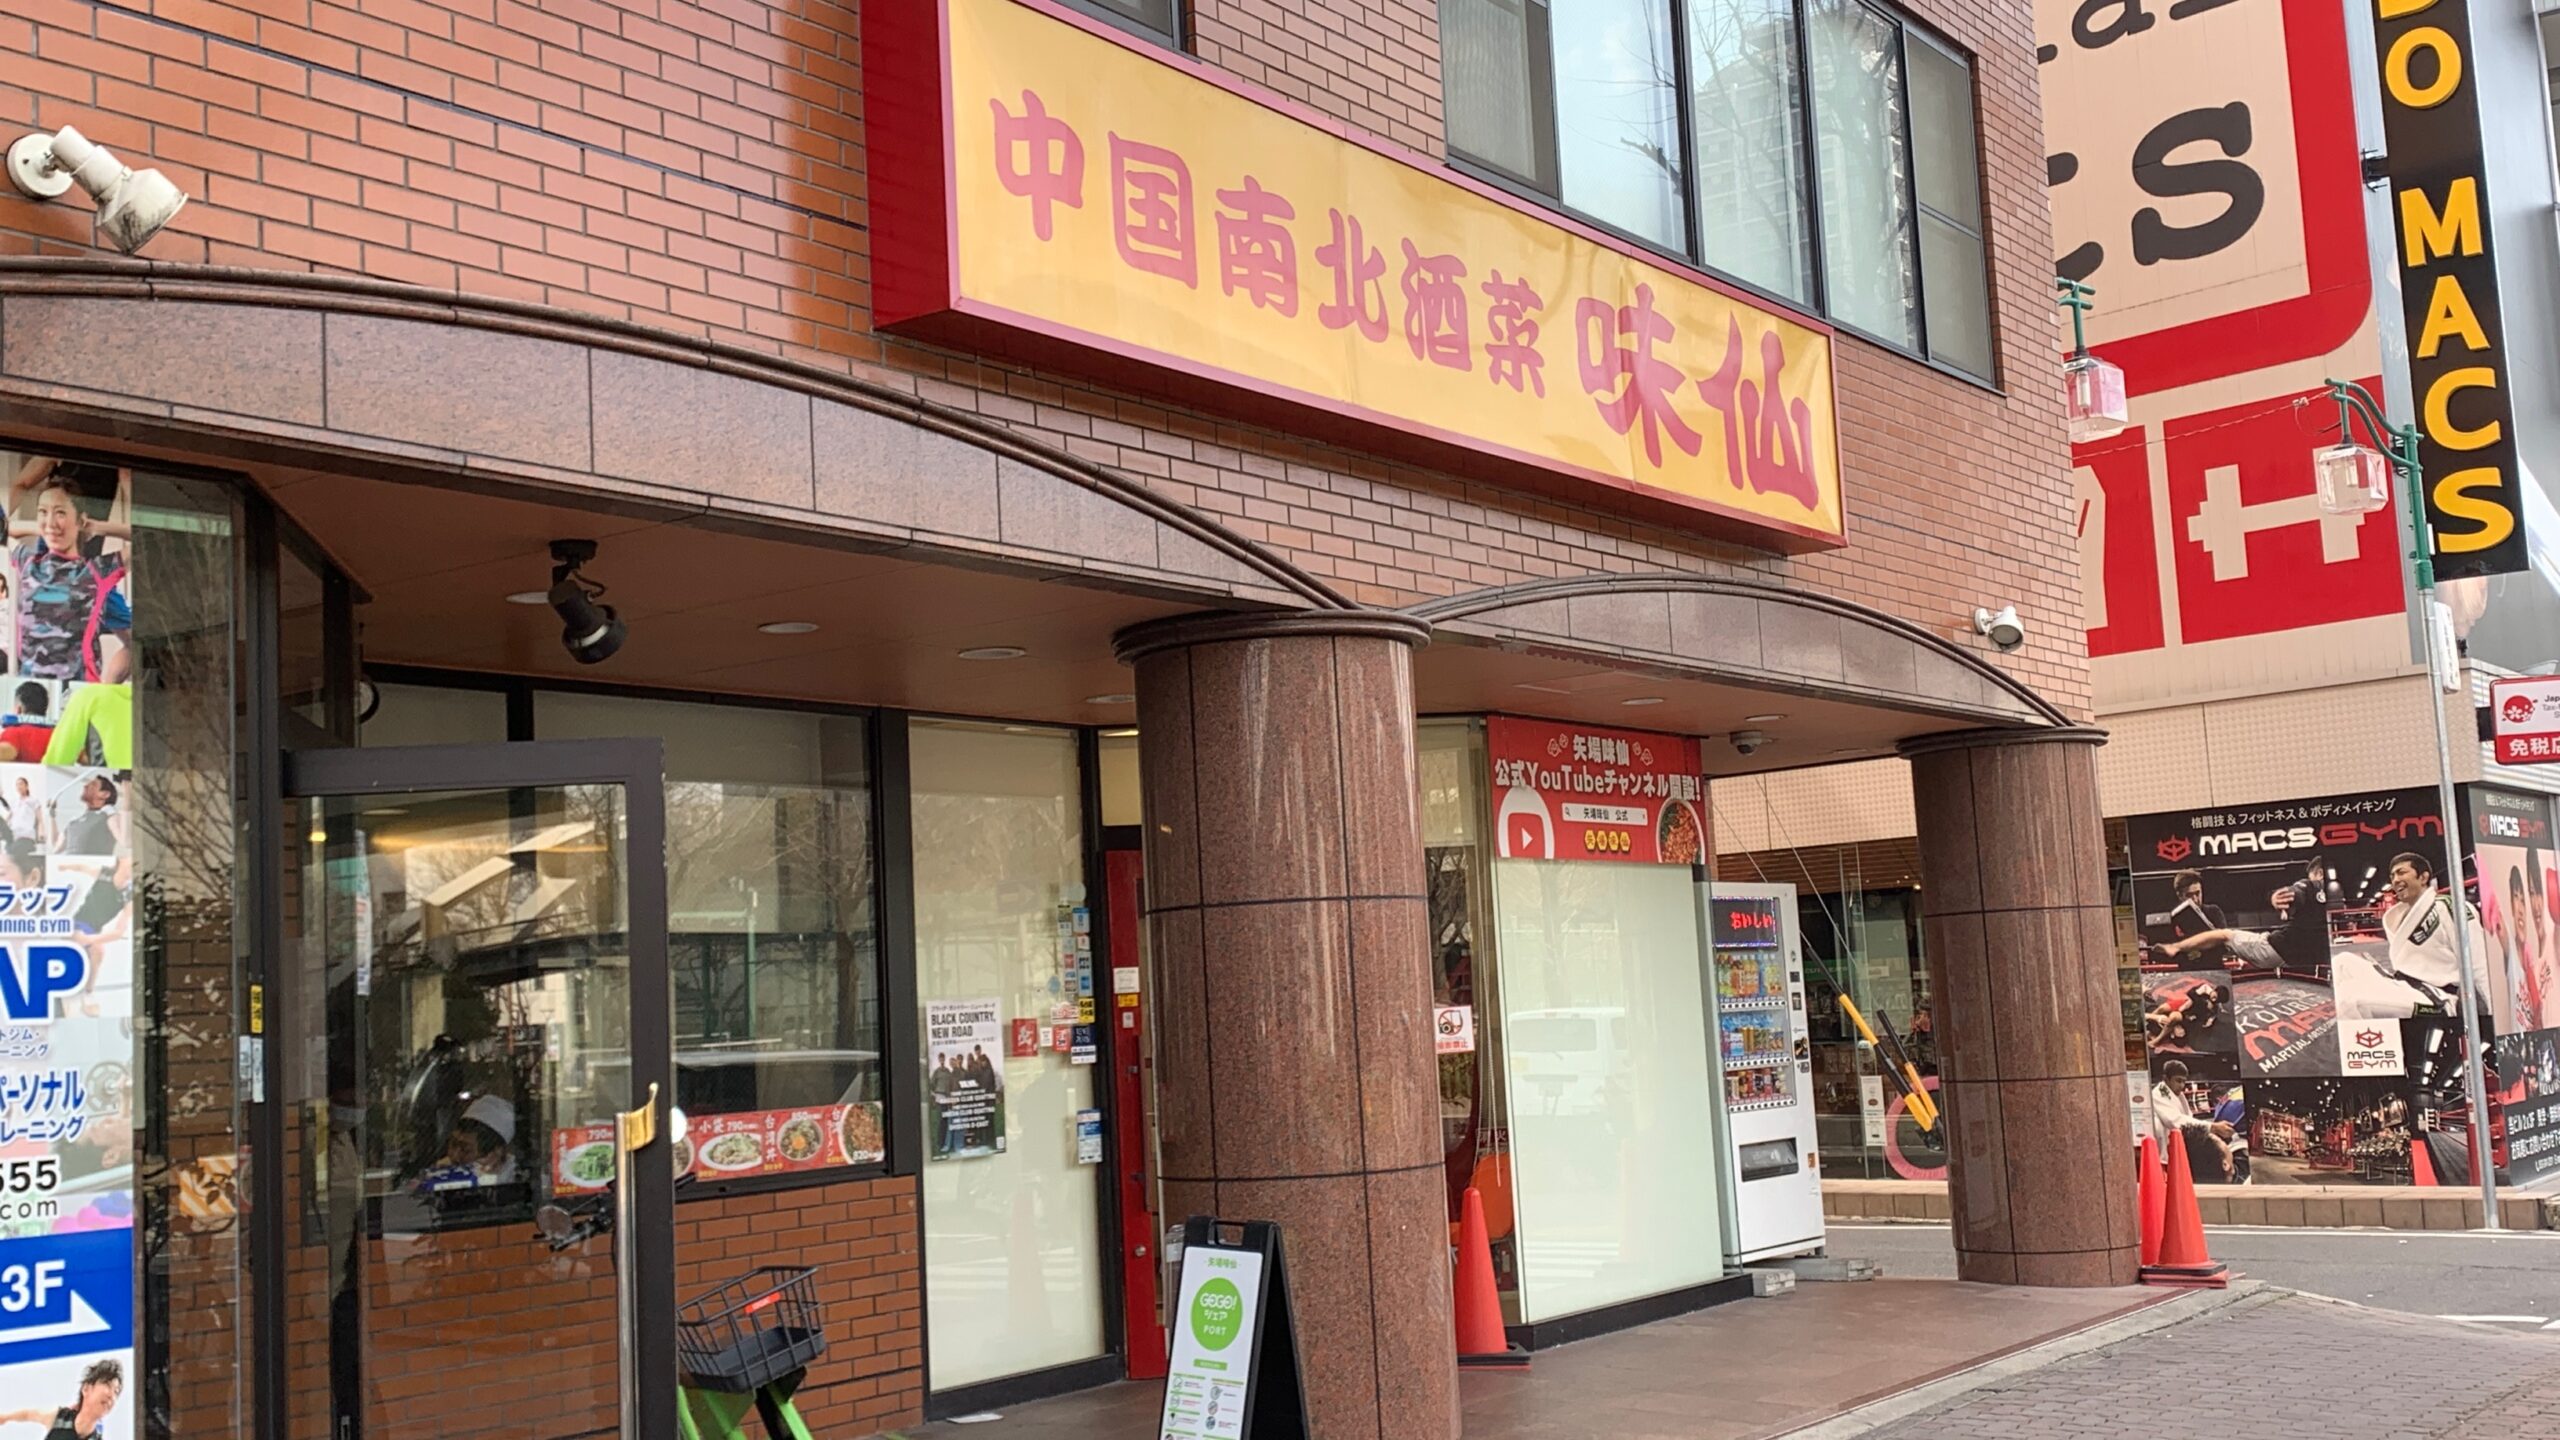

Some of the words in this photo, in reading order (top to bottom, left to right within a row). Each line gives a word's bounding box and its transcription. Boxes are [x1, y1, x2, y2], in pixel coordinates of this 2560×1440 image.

[990, 89, 1545, 399] 中国南北酒菜
[1575, 282, 1819, 512] 味仙
[2399, 176, 2515, 553] MACS
[2545, 695, 2560, 706] Jap
[2191, 814, 2225, 829] 格闘技
[2227, 813, 2237, 826] &
[2239, 809, 2297, 826] フィットネス
[2299, 807, 2308, 819] &
[2310, 798, 2397, 819] ボディメイキング
[40, 918, 71, 933] GYM
[1730, 912, 1773, 930] おいしい
[931, 1013, 957, 1026] BLACK
[959, 1011, 996, 1023] COUNTRY,
[931, 1027, 949, 1039] NEW
[952, 1025, 973, 1037] ROAD
[2347, 1051, 2397, 1060] MACS
[2347, 1060, 2397, 1069] GYM
[1, 1259, 66, 1312] 3F
[1203, 1324, 1227, 1336] PORT
